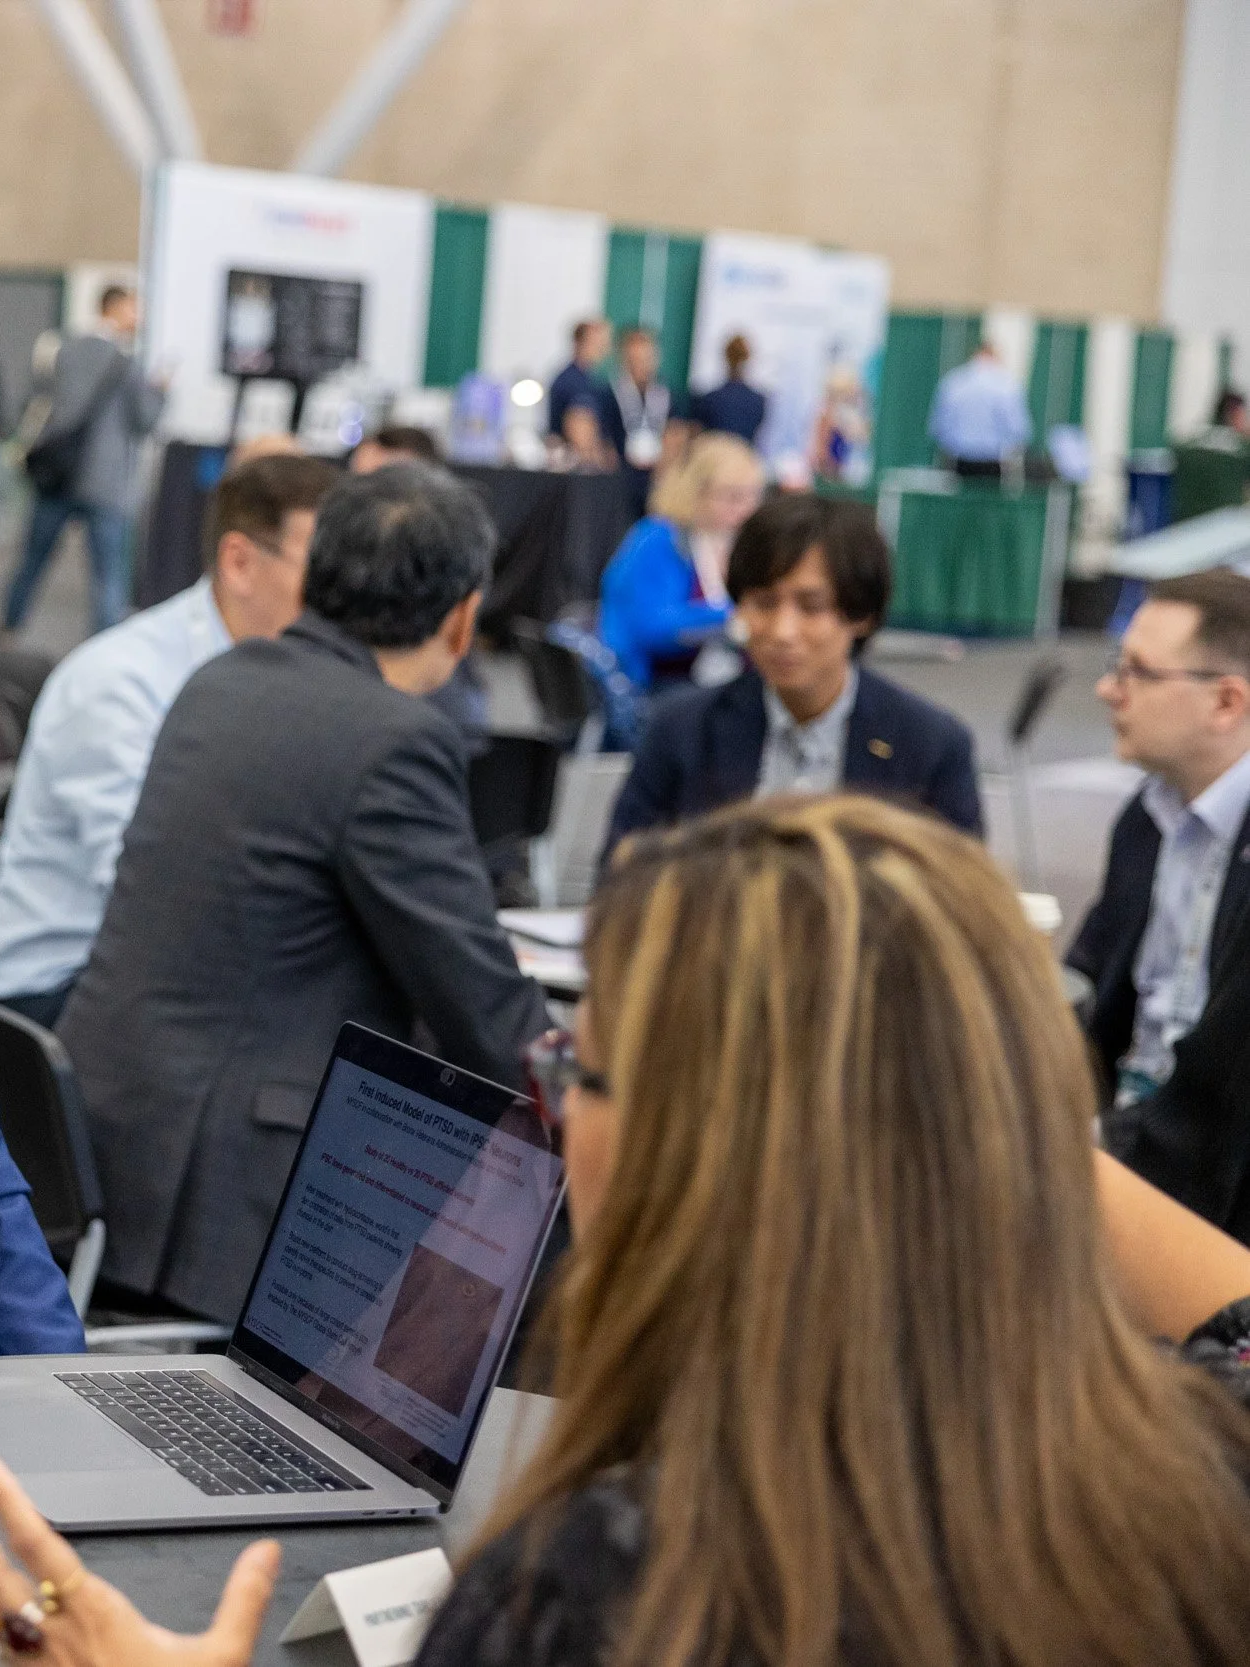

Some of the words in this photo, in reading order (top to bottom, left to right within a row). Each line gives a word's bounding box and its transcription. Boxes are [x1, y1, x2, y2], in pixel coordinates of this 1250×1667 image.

[357, 1080, 375, 1098] First
[373, 1087, 403, 1111] Induced
[401, 1100, 425, 1121] Model
[422, 1110, 433, 1125] of
[431, 1114, 454, 1135] PTSD
[452, 1123, 470, 1142] with
